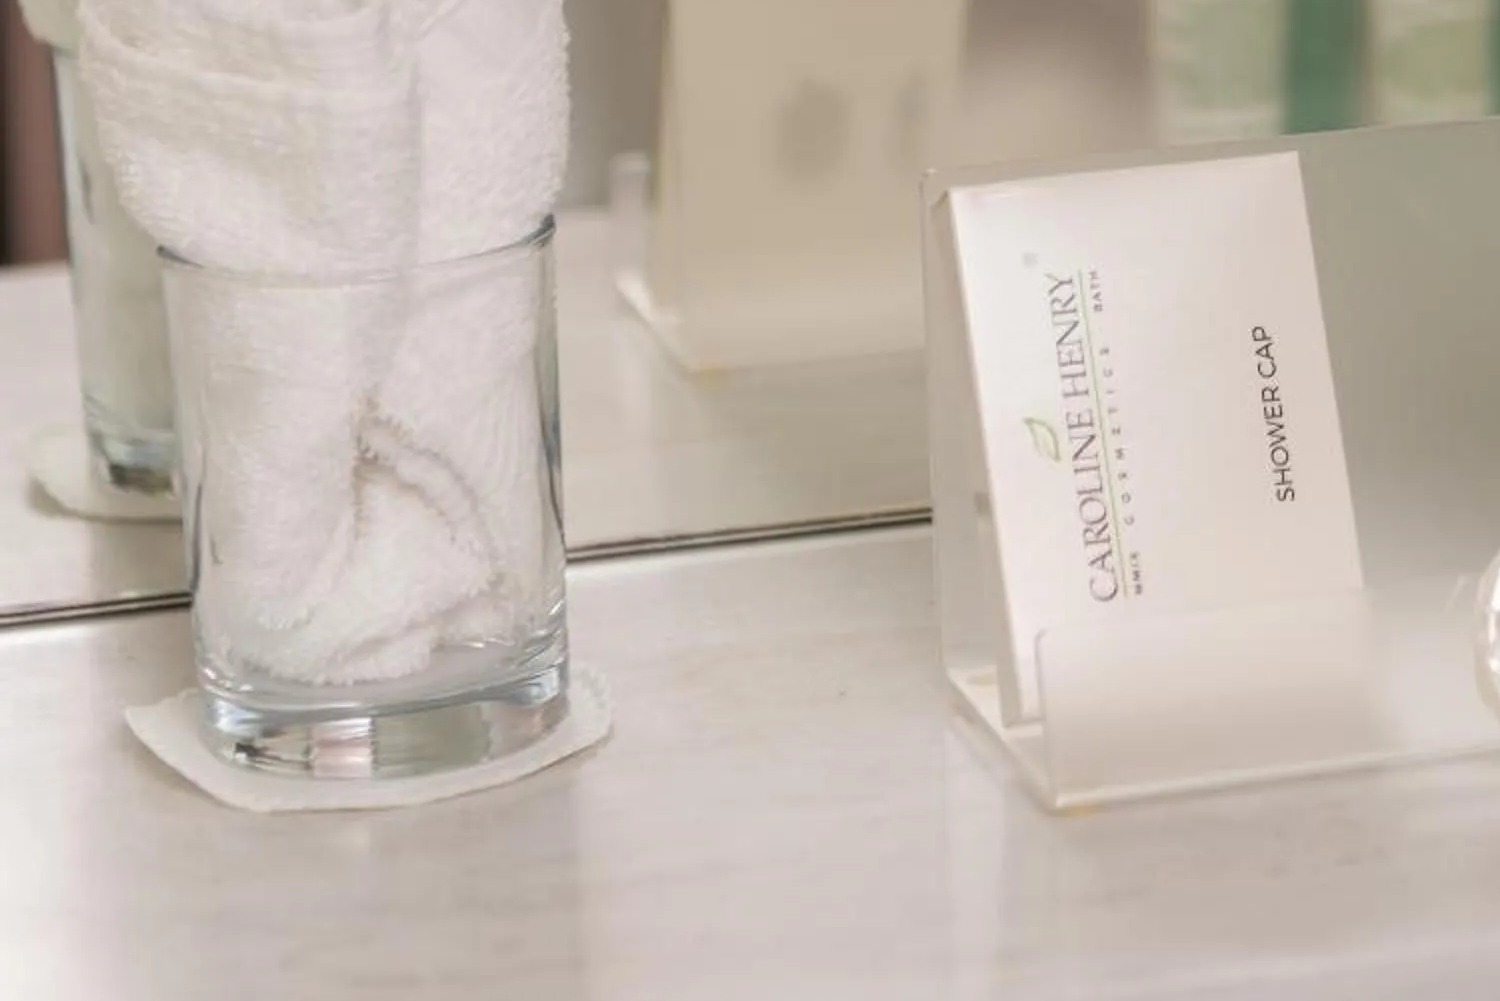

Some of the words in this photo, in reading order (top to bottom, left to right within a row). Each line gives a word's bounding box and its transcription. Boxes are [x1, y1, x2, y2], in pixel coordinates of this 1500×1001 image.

[1045, 273, 1089, 398] HENRY
[1089, 271, 1103, 312] BATH
[1251, 326, 1277, 379] CAP
[1100, 346, 1135, 526] COSMETICS
[1261, 386, 1295, 502] SHOWER
[1066, 408, 1118, 601] CAROLINE
